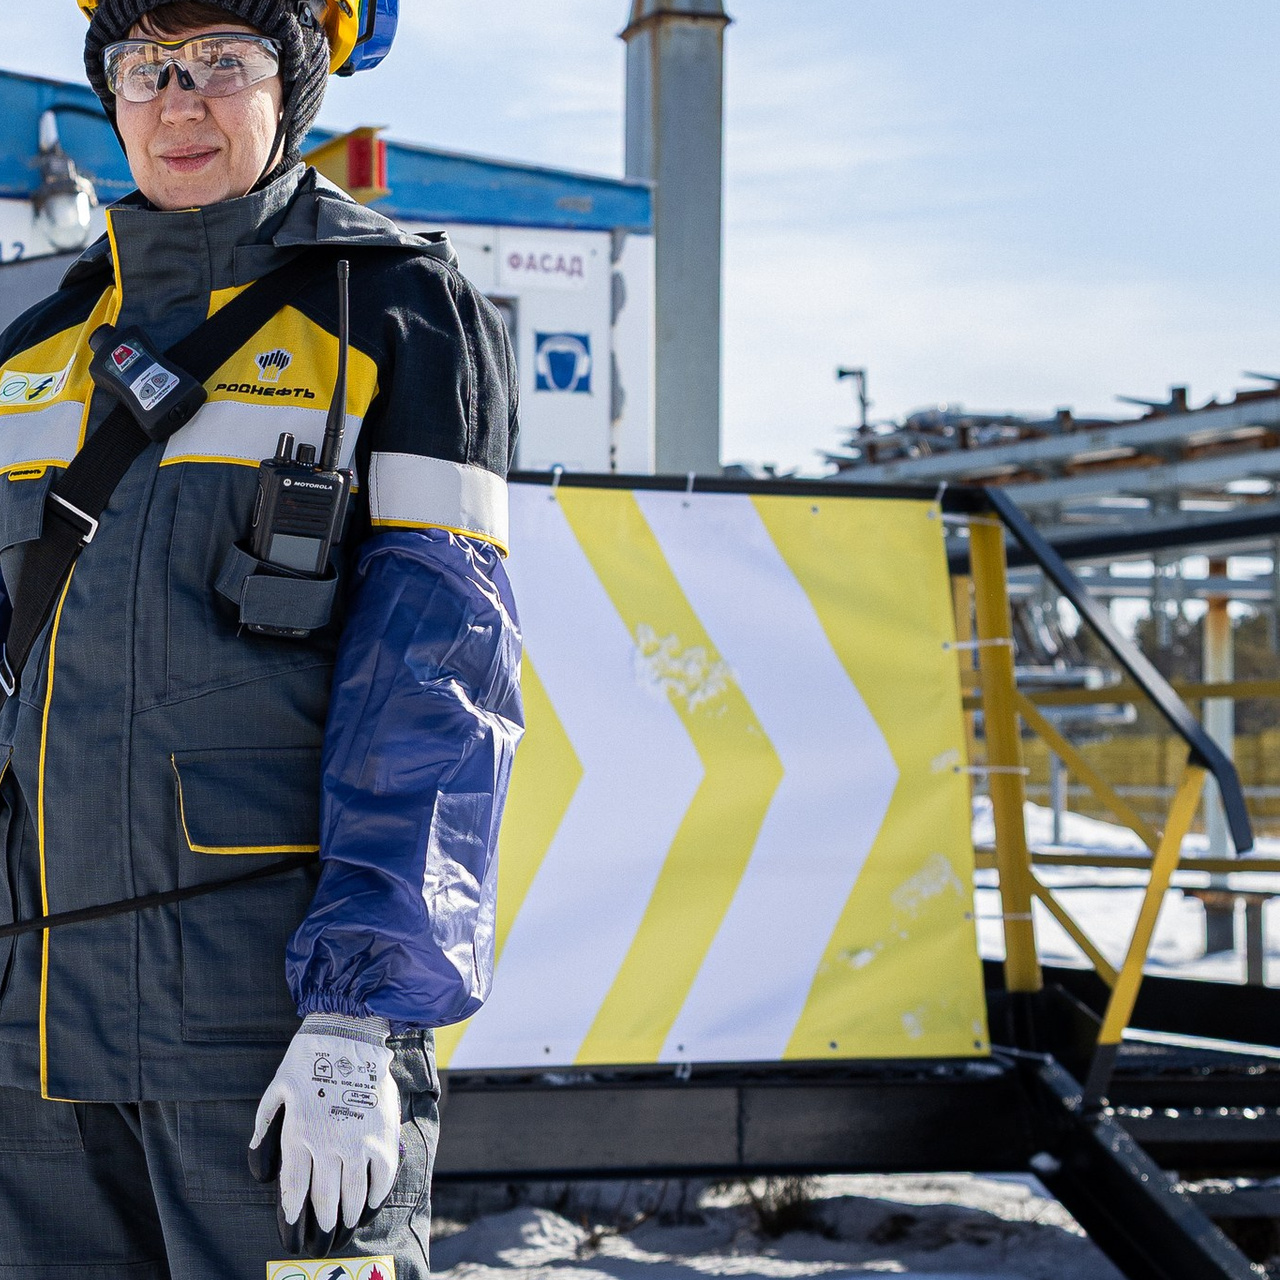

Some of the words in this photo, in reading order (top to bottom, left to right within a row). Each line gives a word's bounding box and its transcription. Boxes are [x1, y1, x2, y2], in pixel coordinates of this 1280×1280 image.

[12, 241, 26, 261] 2
[507, 252, 584, 277] ФАСАД
[214, 383, 316, 399] РОСНЕФТЬ
[293, 481, 333, 491] MOTOROLA
[318, 1088, 326, 1098] 9
